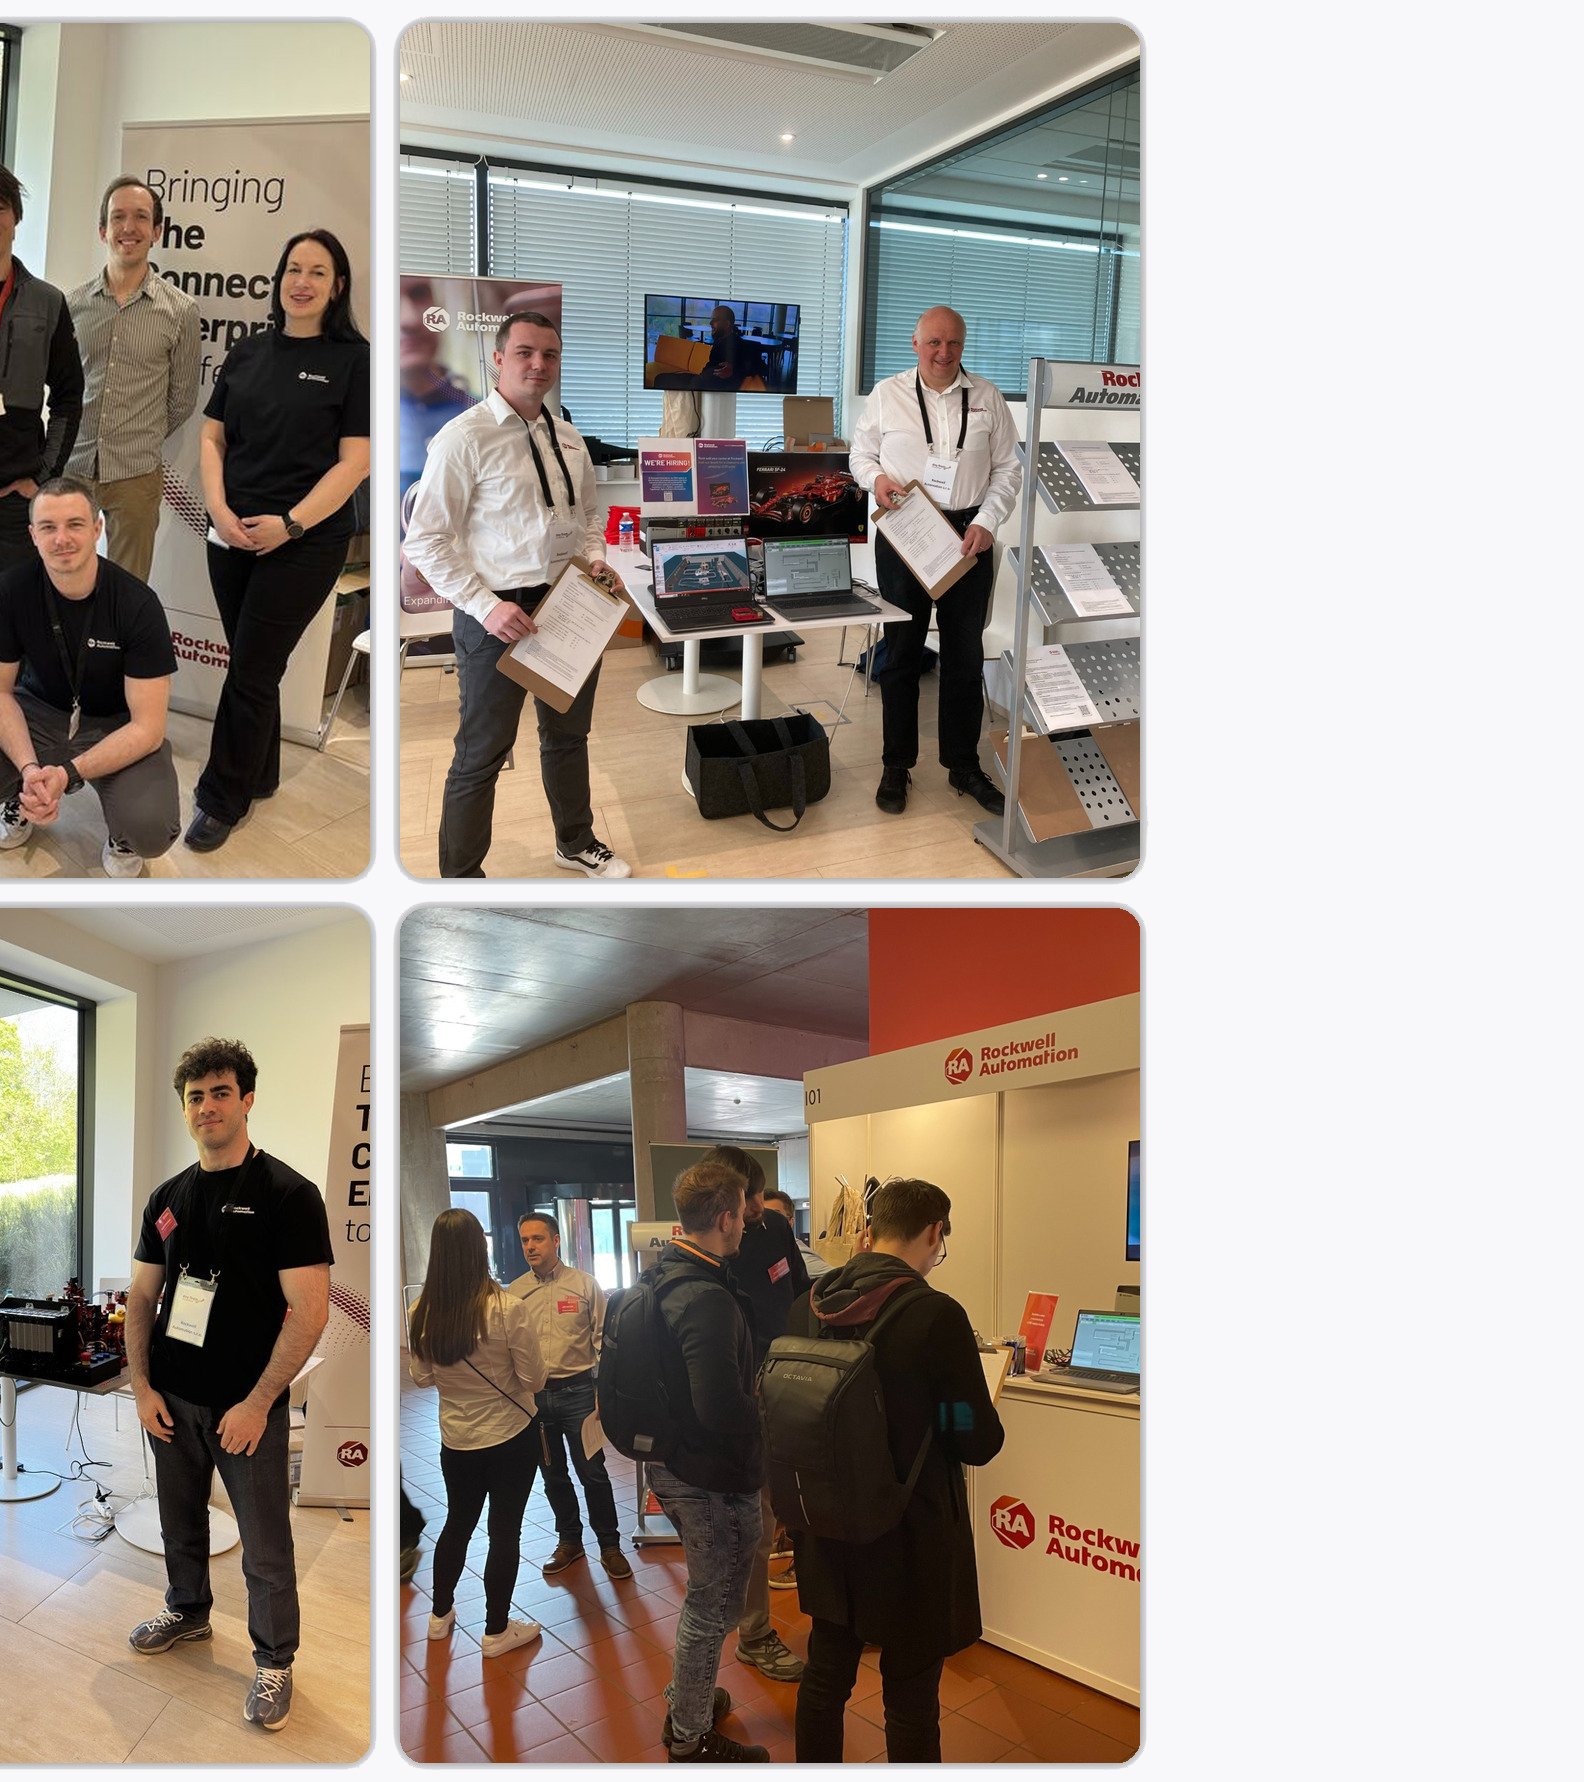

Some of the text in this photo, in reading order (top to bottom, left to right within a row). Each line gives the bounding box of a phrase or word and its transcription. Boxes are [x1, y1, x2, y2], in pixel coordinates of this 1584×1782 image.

[147, 169, 284, 213] Bringing
[162, 217, 205, 250] he
[149, 262, 276, 300] onnec
[457, 311, 514, 323] Rockwe
[1068, 387, 1140, 405] Autom
[404, 596, 450, 607] Expandi
[981, 1032, 1056, 1061] Rockwell
[979, 1047, 1079, 1076] Automation
[346, 1220, 370, 1242] to
[783, 1373, 812, 1381] OCTAVIA
[1046, 1537, 1140, 1582] Autom
